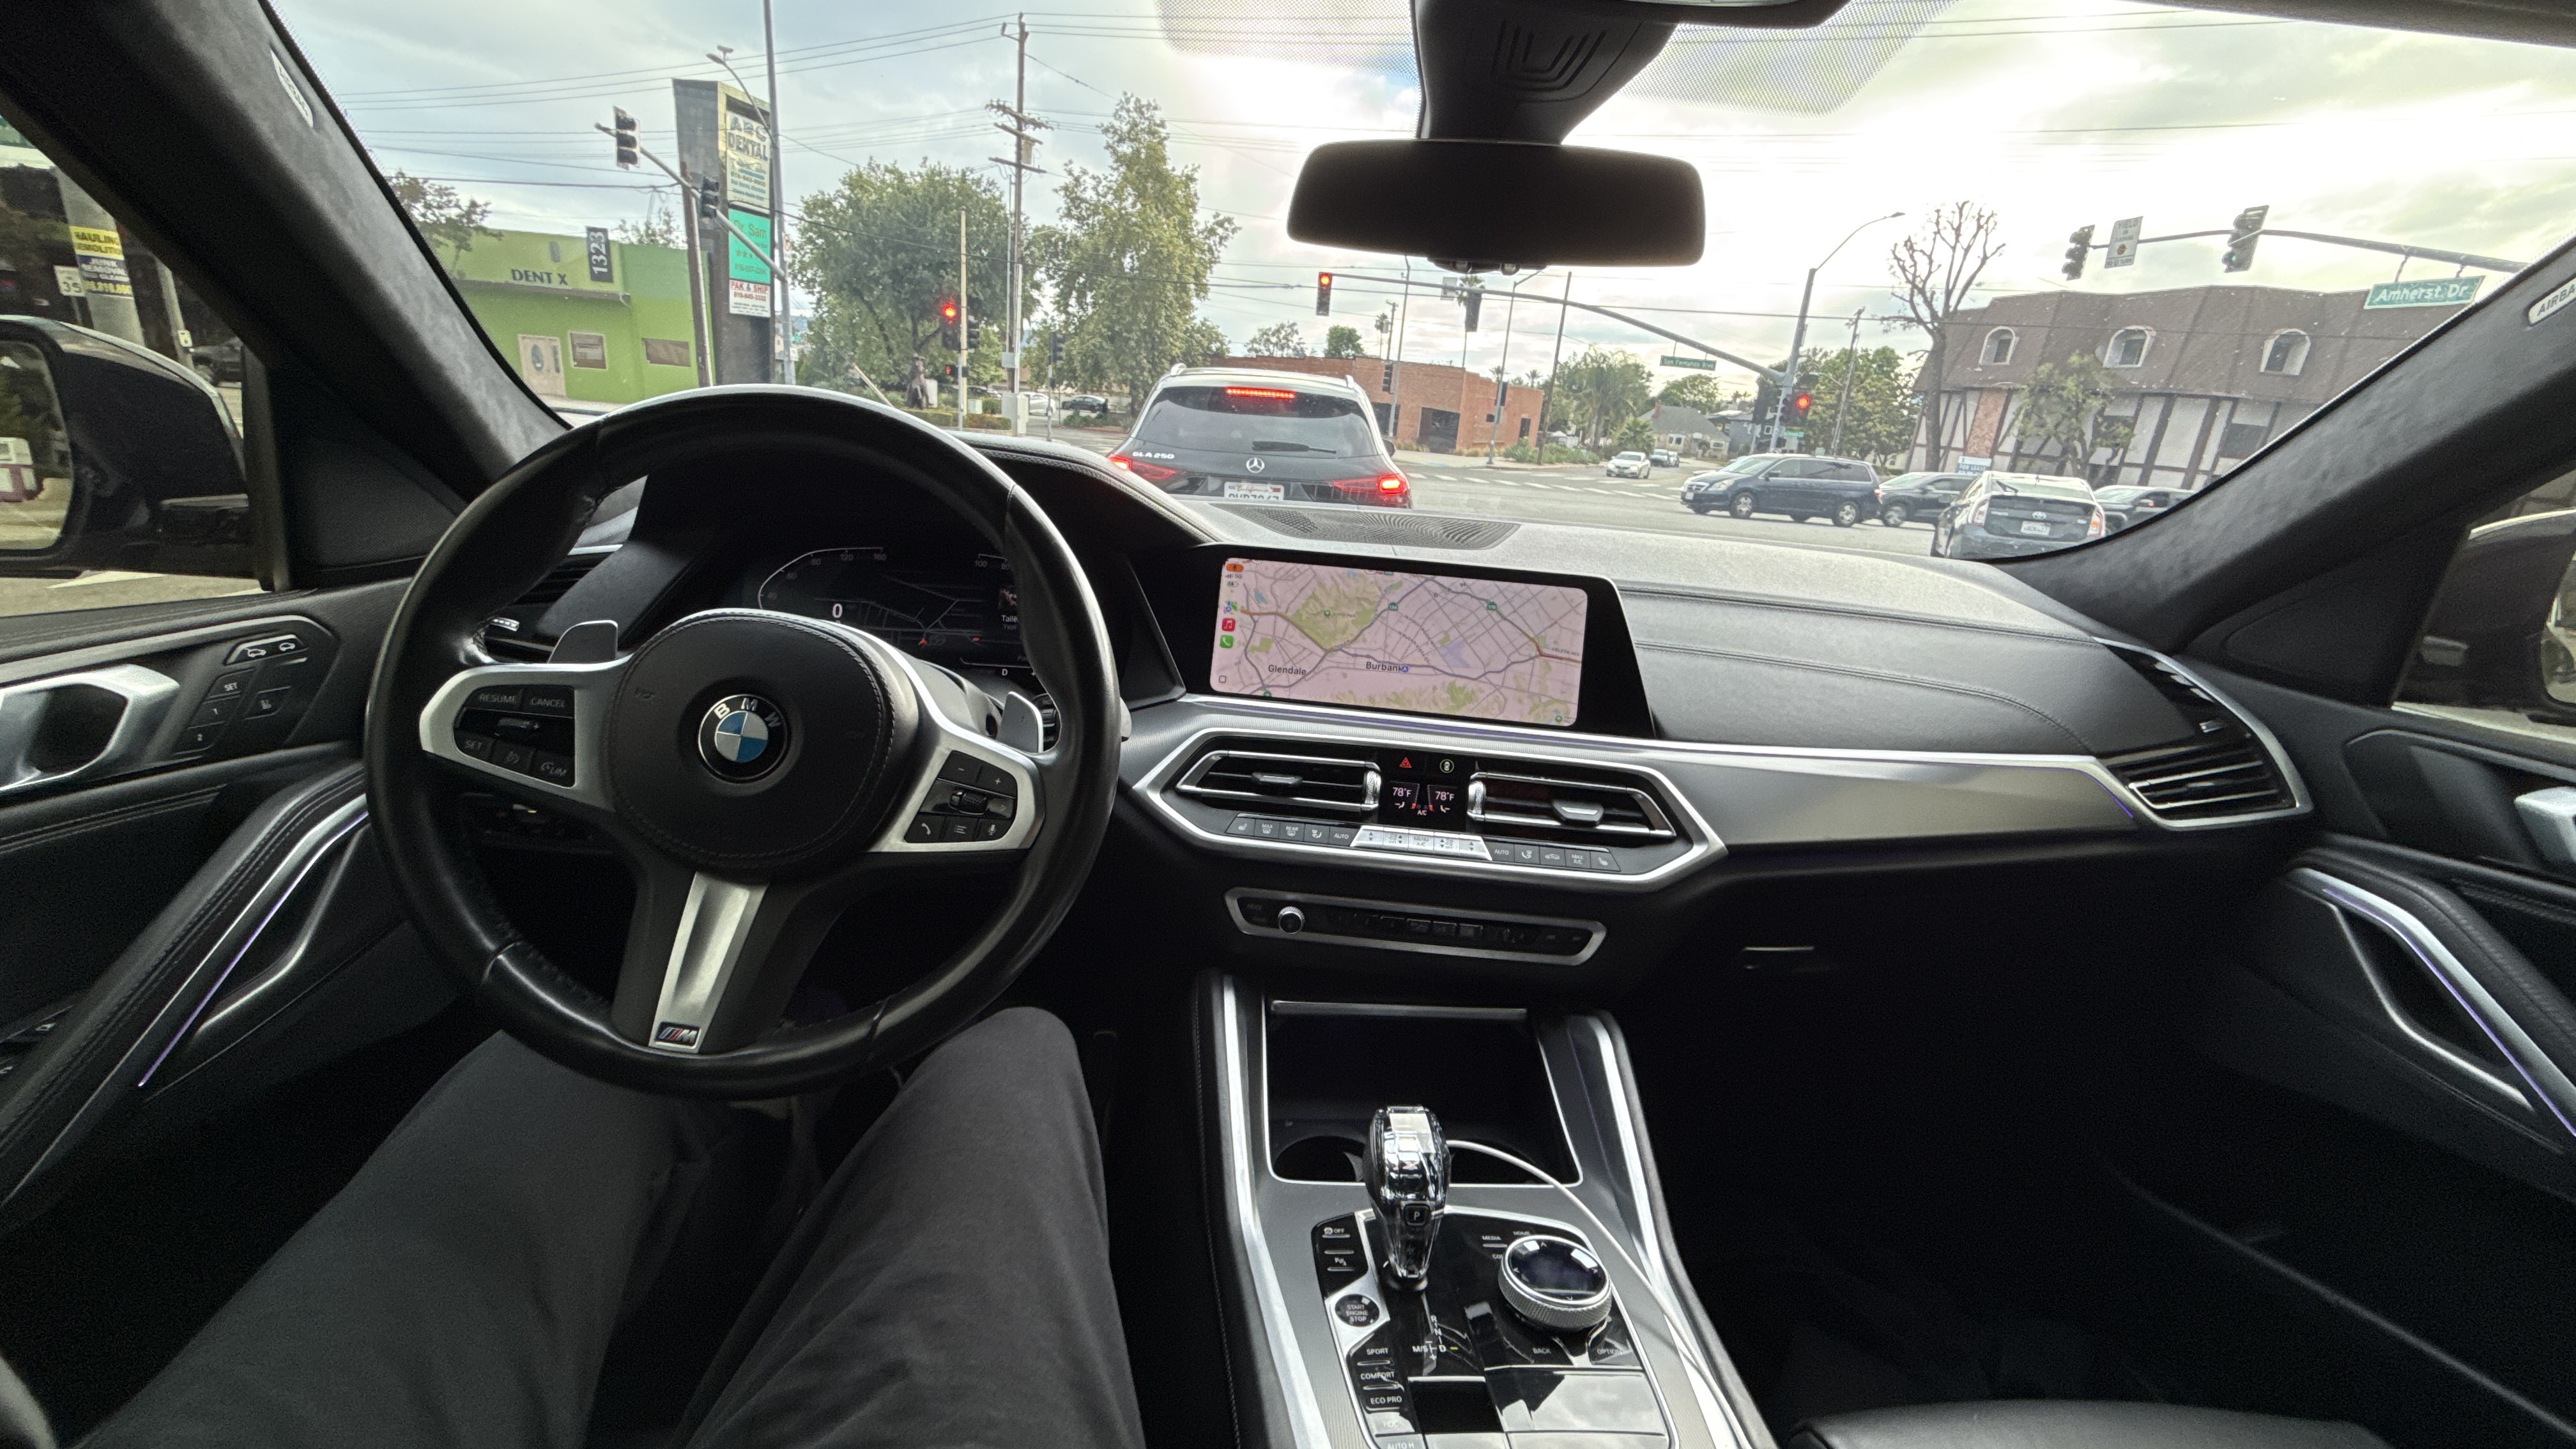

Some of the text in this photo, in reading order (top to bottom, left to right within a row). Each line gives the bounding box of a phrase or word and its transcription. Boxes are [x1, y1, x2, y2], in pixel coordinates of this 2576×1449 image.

[728, 132, 768, 161] DENTAL
[589, 232, 608, 275] 1323
[511, 269, 568, 285] DENT X
[62, 282, 82, 293] 35
[2373, 284, 2470, 302] Amherst Dr
[832, 603, 843, 618] 0
[1268, 664, 1307, 675] Glendale
[1365, 661, 1402, 672] Burbank
[224, 682, 238, 691] SET
[479, 694, 516, 703] RESUME
[531, 698, 565, 708] CANCEL
[714, 698, 781, 728] BMW
[464, 740, 482, 749] SET
[1392, 786, 1412, 797] 78°F
[1435, 790, 1455, 801] 78°F
[1413, 1211, 1420, 1221] P
[1434, 1328, 1442, 1337] N
[1360, 1371, 1395, 1380] COMFORT
[1386, 1395, 1402, 1404] PRO
